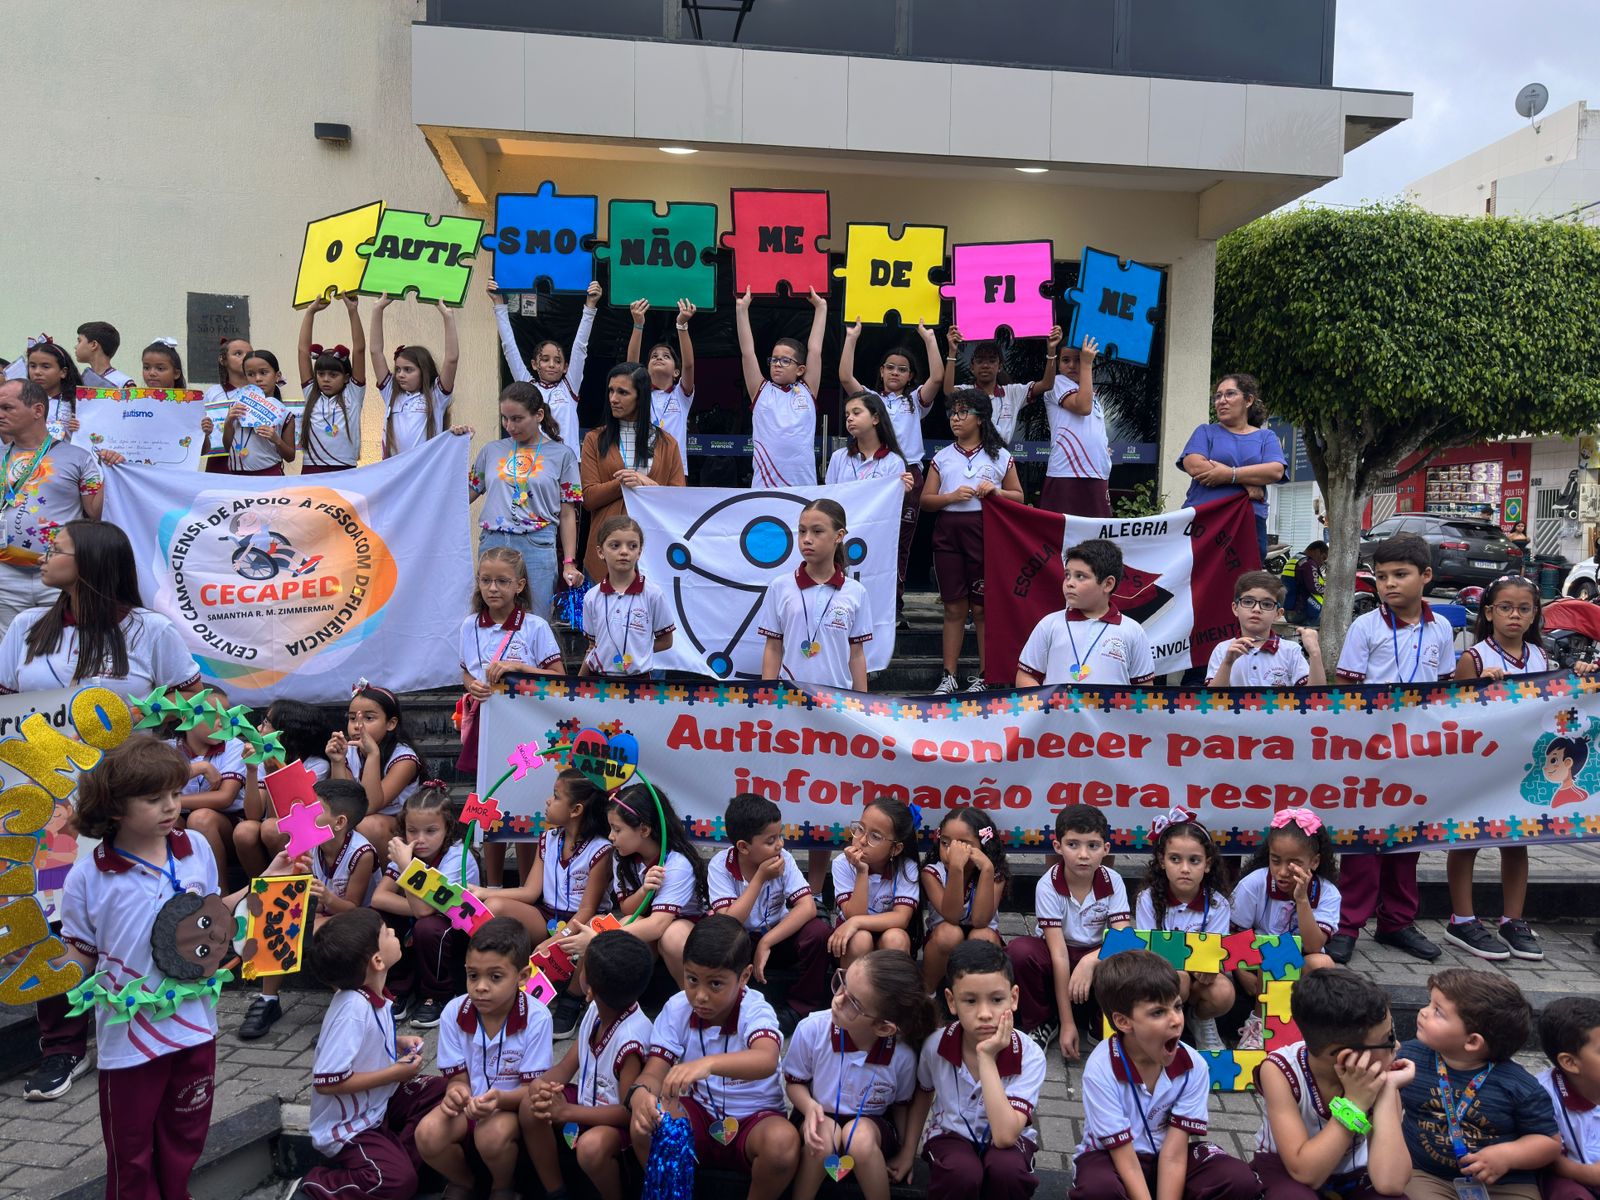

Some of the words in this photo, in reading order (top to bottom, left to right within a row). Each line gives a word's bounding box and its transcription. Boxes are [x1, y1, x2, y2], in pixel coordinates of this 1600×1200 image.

[326, 239, 343, 263] O
[374, 236, 461, 267] AUTI
[498, 227, 577, 255] SMO
[618, 228, 698, 269] NÃO
[757, 225, 806, 254] ME
[869, 260, 914, 288] DE
[983, 275, 1017, 304] FI
[1098, 287, 1138, 322] NE
[248, 391, 278, 412] RESPEITE
[232, 497, 291, 513] APOIO
[298, 497, 311, 508] À
[1504, 489, 1515, 497] AQUI
[1515, 488, 1526, 496] TEM
[206, 506, 231, 528] DE
[316, 502, 361, 541] PESSOA
[355, 536, 372, 570] COM
[1013, 542, 1056, 599] ESCOLA
[1098, 520, 1169, 540] ALEGRIA
[1182, 521, 1206, 539] DO
[171, 521, 209, 621] CAMOCIENSE
[200, 575, 342, 607] CECAPED
[207, 610, 254, 621] SAMANTHA
[255, 609, 264, 617] R.
[266, 608, 277, 616] M.
[277, 603, 335, 616] ZIMMERMAN
[284, 574, 370, 657] DEFICIÊNCIA
[192, 623, 258, 660] CENTRO
[576, 740, 628, 763] ABRIL
[666, 714, 897, 761] Autismo:
[911, 726, 1152, 764] conhecer
[1166, 732, 1294, 767] para
[1310, 720, 1499, 761] incluir,
[580, 758, 626, 779] AZUL
[466, 805, 489, 817] AMOR
[1046, 780, 1170, 815] gera
[1186, 776, 1428, 813] respeito.
[263, 879, 308, 972] RESPEITO
[328, 1075, 340, 1083] DO
